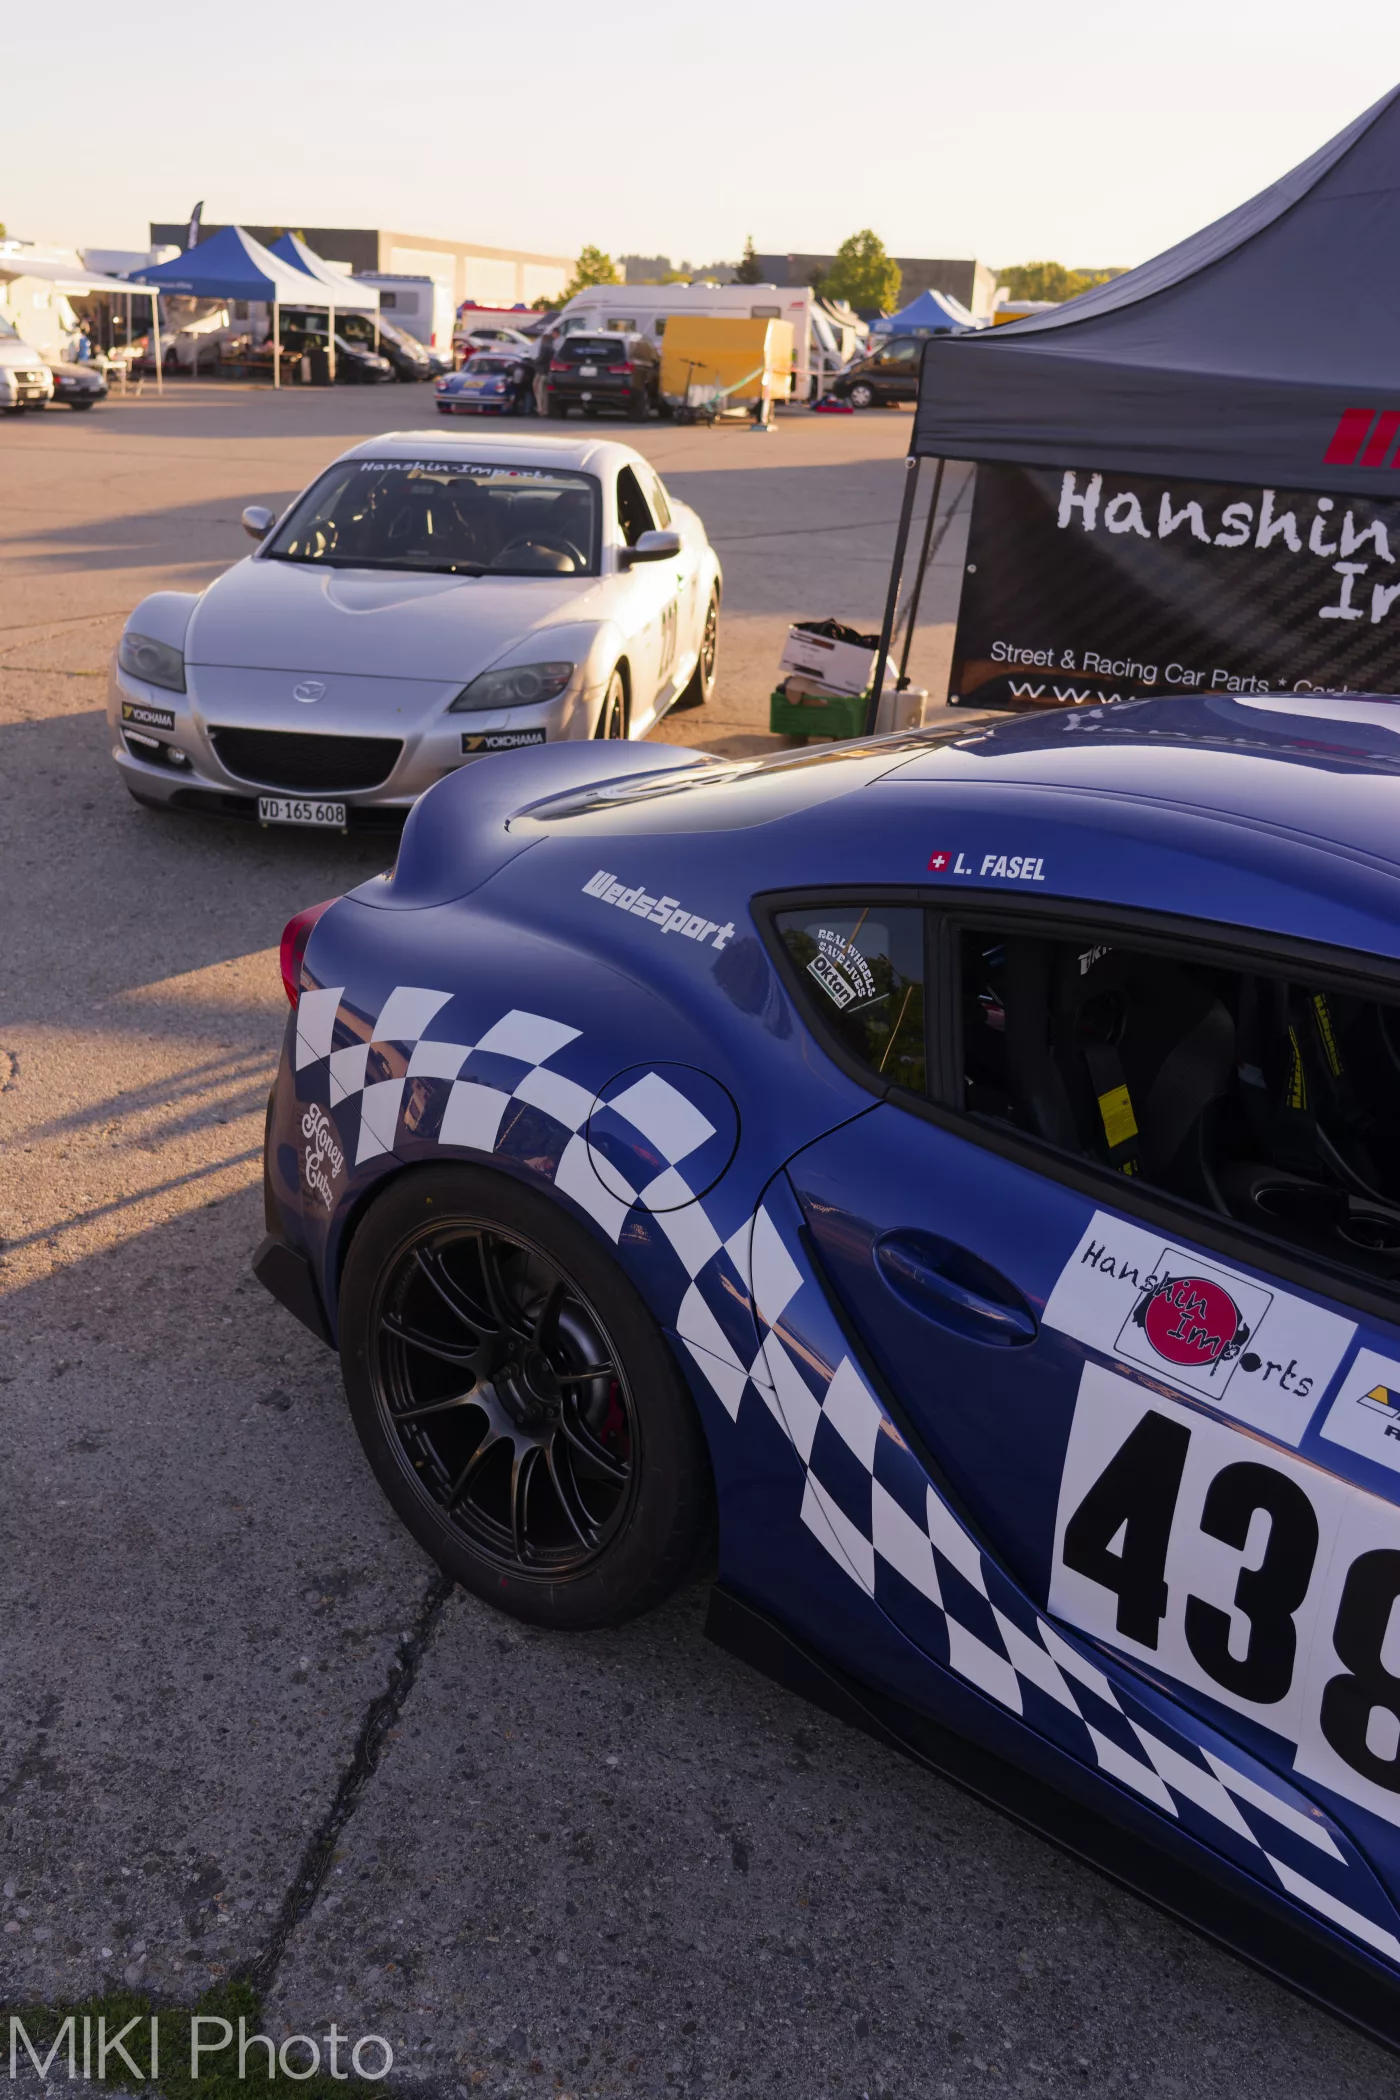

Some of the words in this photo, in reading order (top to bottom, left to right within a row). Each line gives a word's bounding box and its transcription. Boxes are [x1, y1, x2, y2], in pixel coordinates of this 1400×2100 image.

[1057, 470, 1396, 563] Hanshin
[990, 641, 1054, 667] Street
[1060, 649, 1075, 670] &
[1083, 652, 1158, 685] Racing
[1164, 663, 1205, 687] Car
[1211, 669, 1269, 693] Parts
[132, 709, 173, 726] YOKOHAMA
[485, 733, 543, 748] YOKOHAMA
[953, 853, 972, 874] L.
[980, 855, 1045, 880] FASEL
[581, 869, 735, 950] WedsSport
[814, 956, 850, 1003] Oktan
[818, 929, 846, 949] REAL
[847, 944, 876, 997] WHEELS
[818, 942, 846, 964] SAVE
[843, 960, 866, 997] LIVES
[302, 1103, 344, 1178] Honey
[1081, 1240, 1206, 1318] Hanshin
